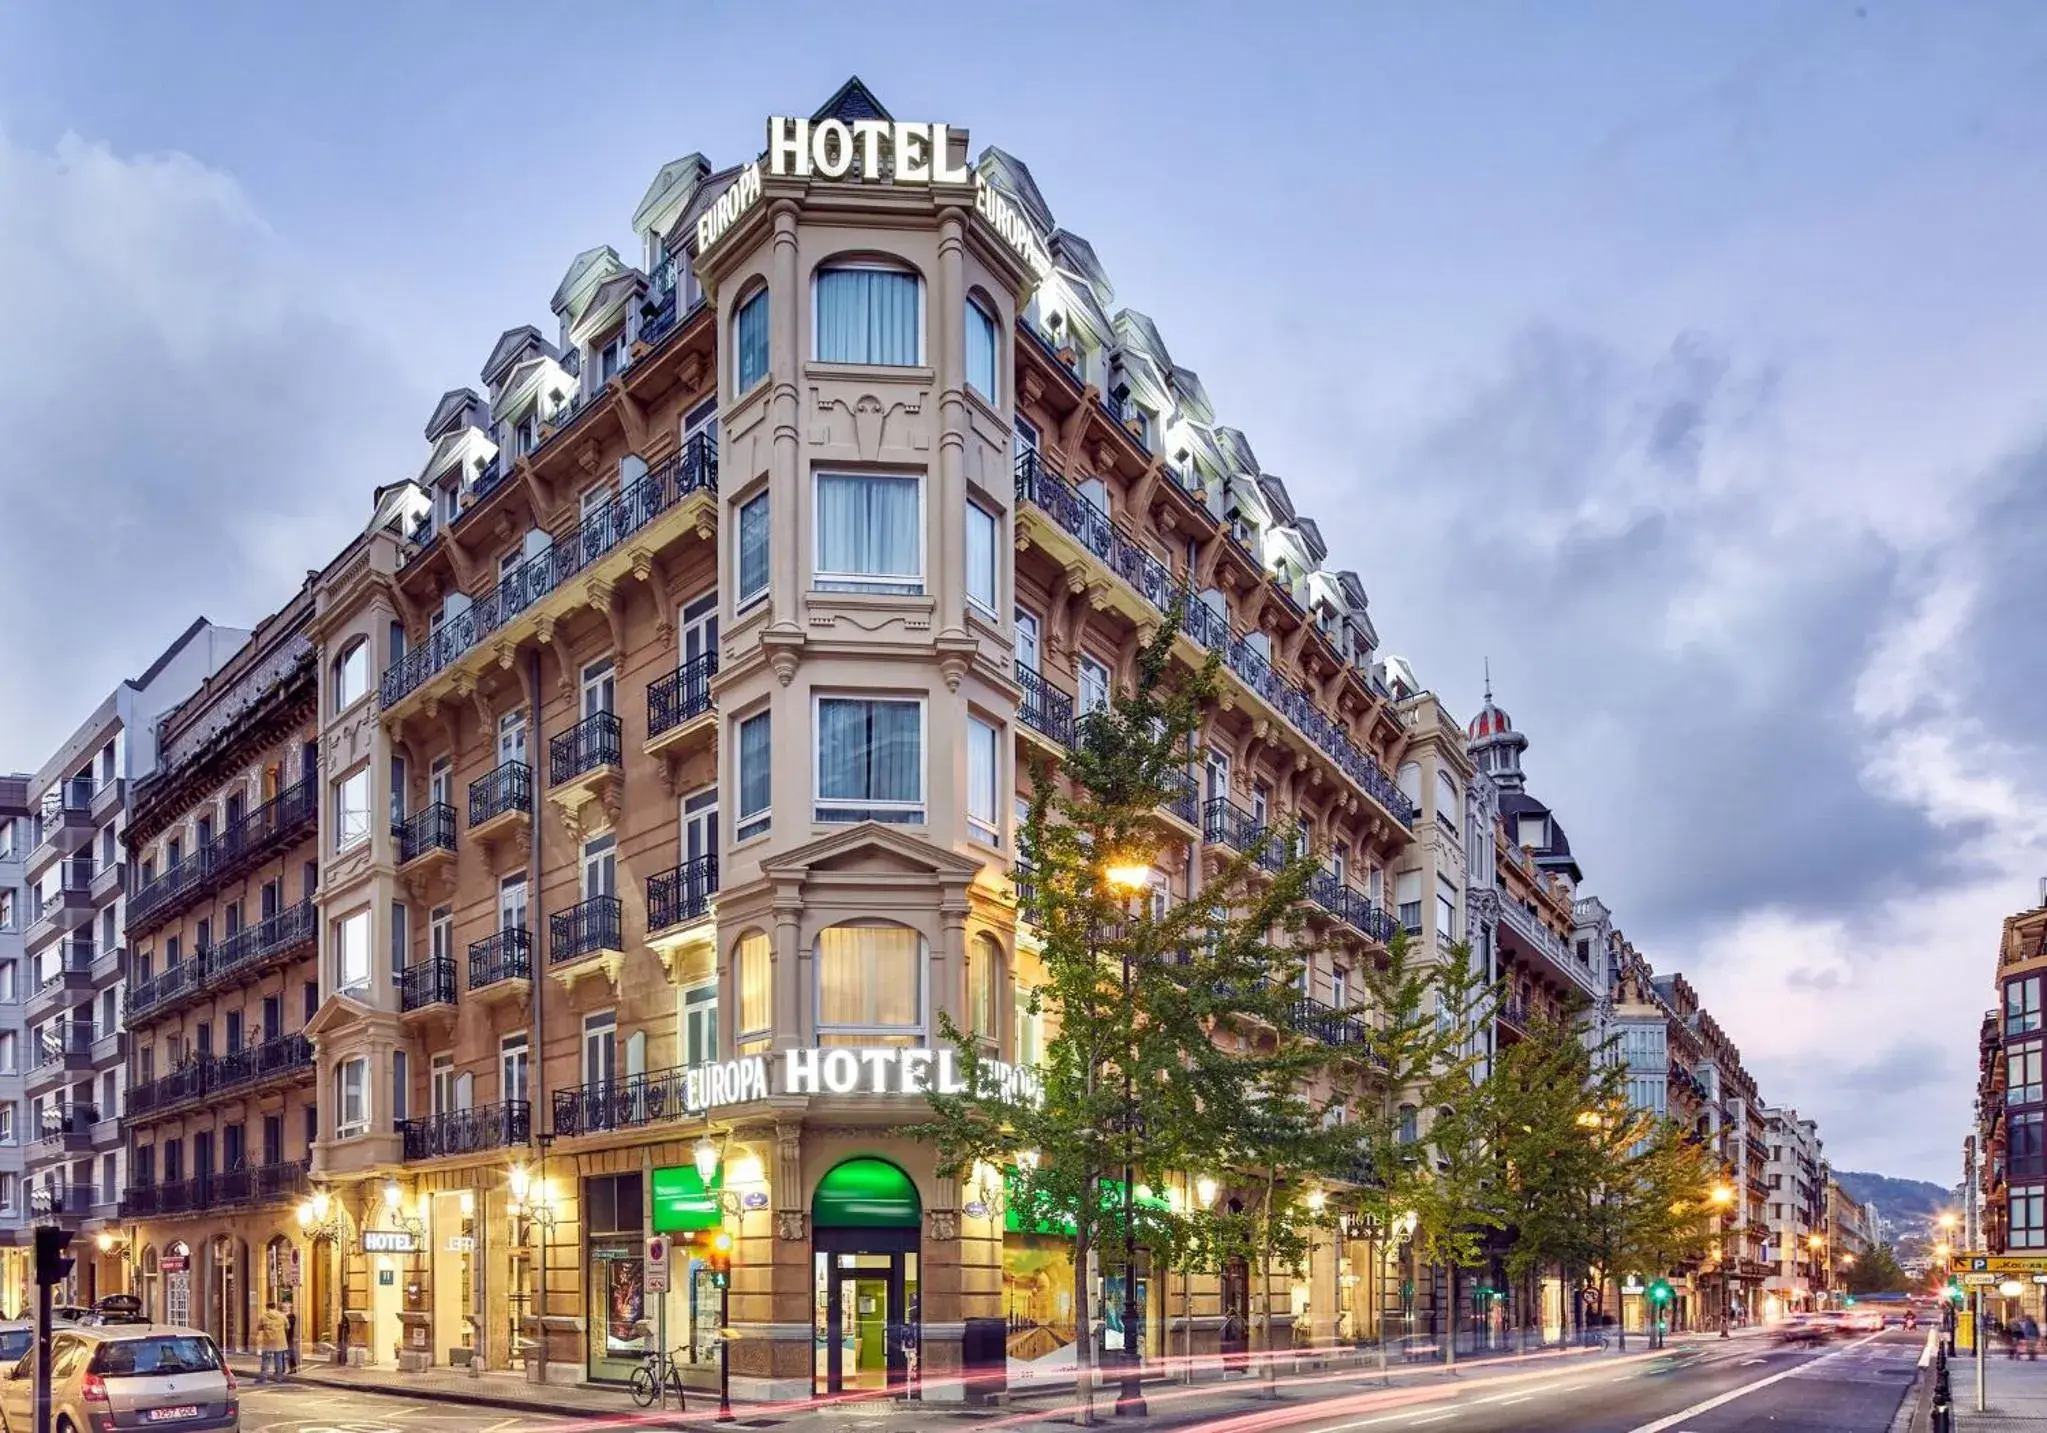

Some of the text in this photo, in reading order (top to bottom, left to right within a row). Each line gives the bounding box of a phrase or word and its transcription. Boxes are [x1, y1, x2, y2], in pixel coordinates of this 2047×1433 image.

[770, 116, 968, 184] HOTEL
[697, 161, 761, 254] EUROPA
[975, 171, 1036, 261] EUROPA
[687, 1055, 768, 1112] EUROPA
[785, 1048, 970, 1094] HOTEL
[365, 1232, 412, 1250] HOTEL
